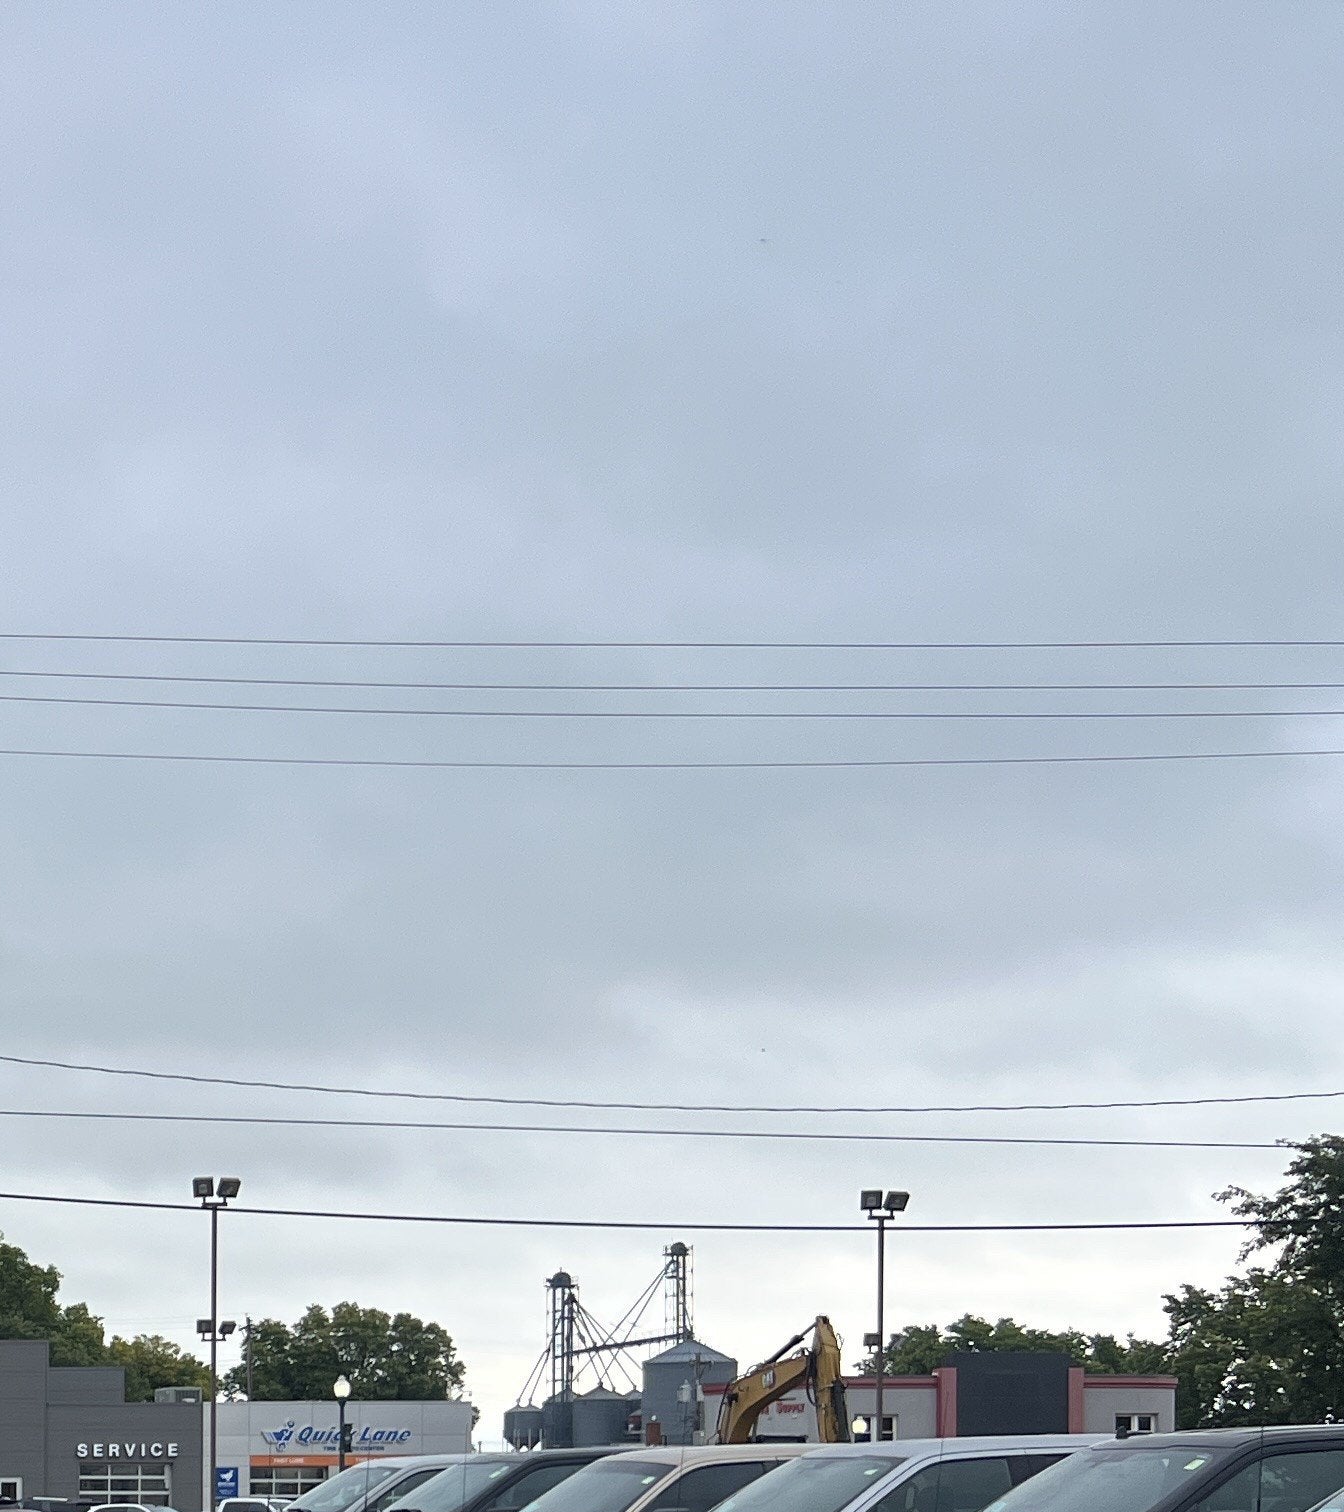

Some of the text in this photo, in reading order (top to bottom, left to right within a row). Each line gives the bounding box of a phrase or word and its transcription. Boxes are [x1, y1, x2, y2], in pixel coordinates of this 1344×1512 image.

[298, 1426, 412, 1443] Quic Lane
[76, 1443, 179, 1458] SERVICE
